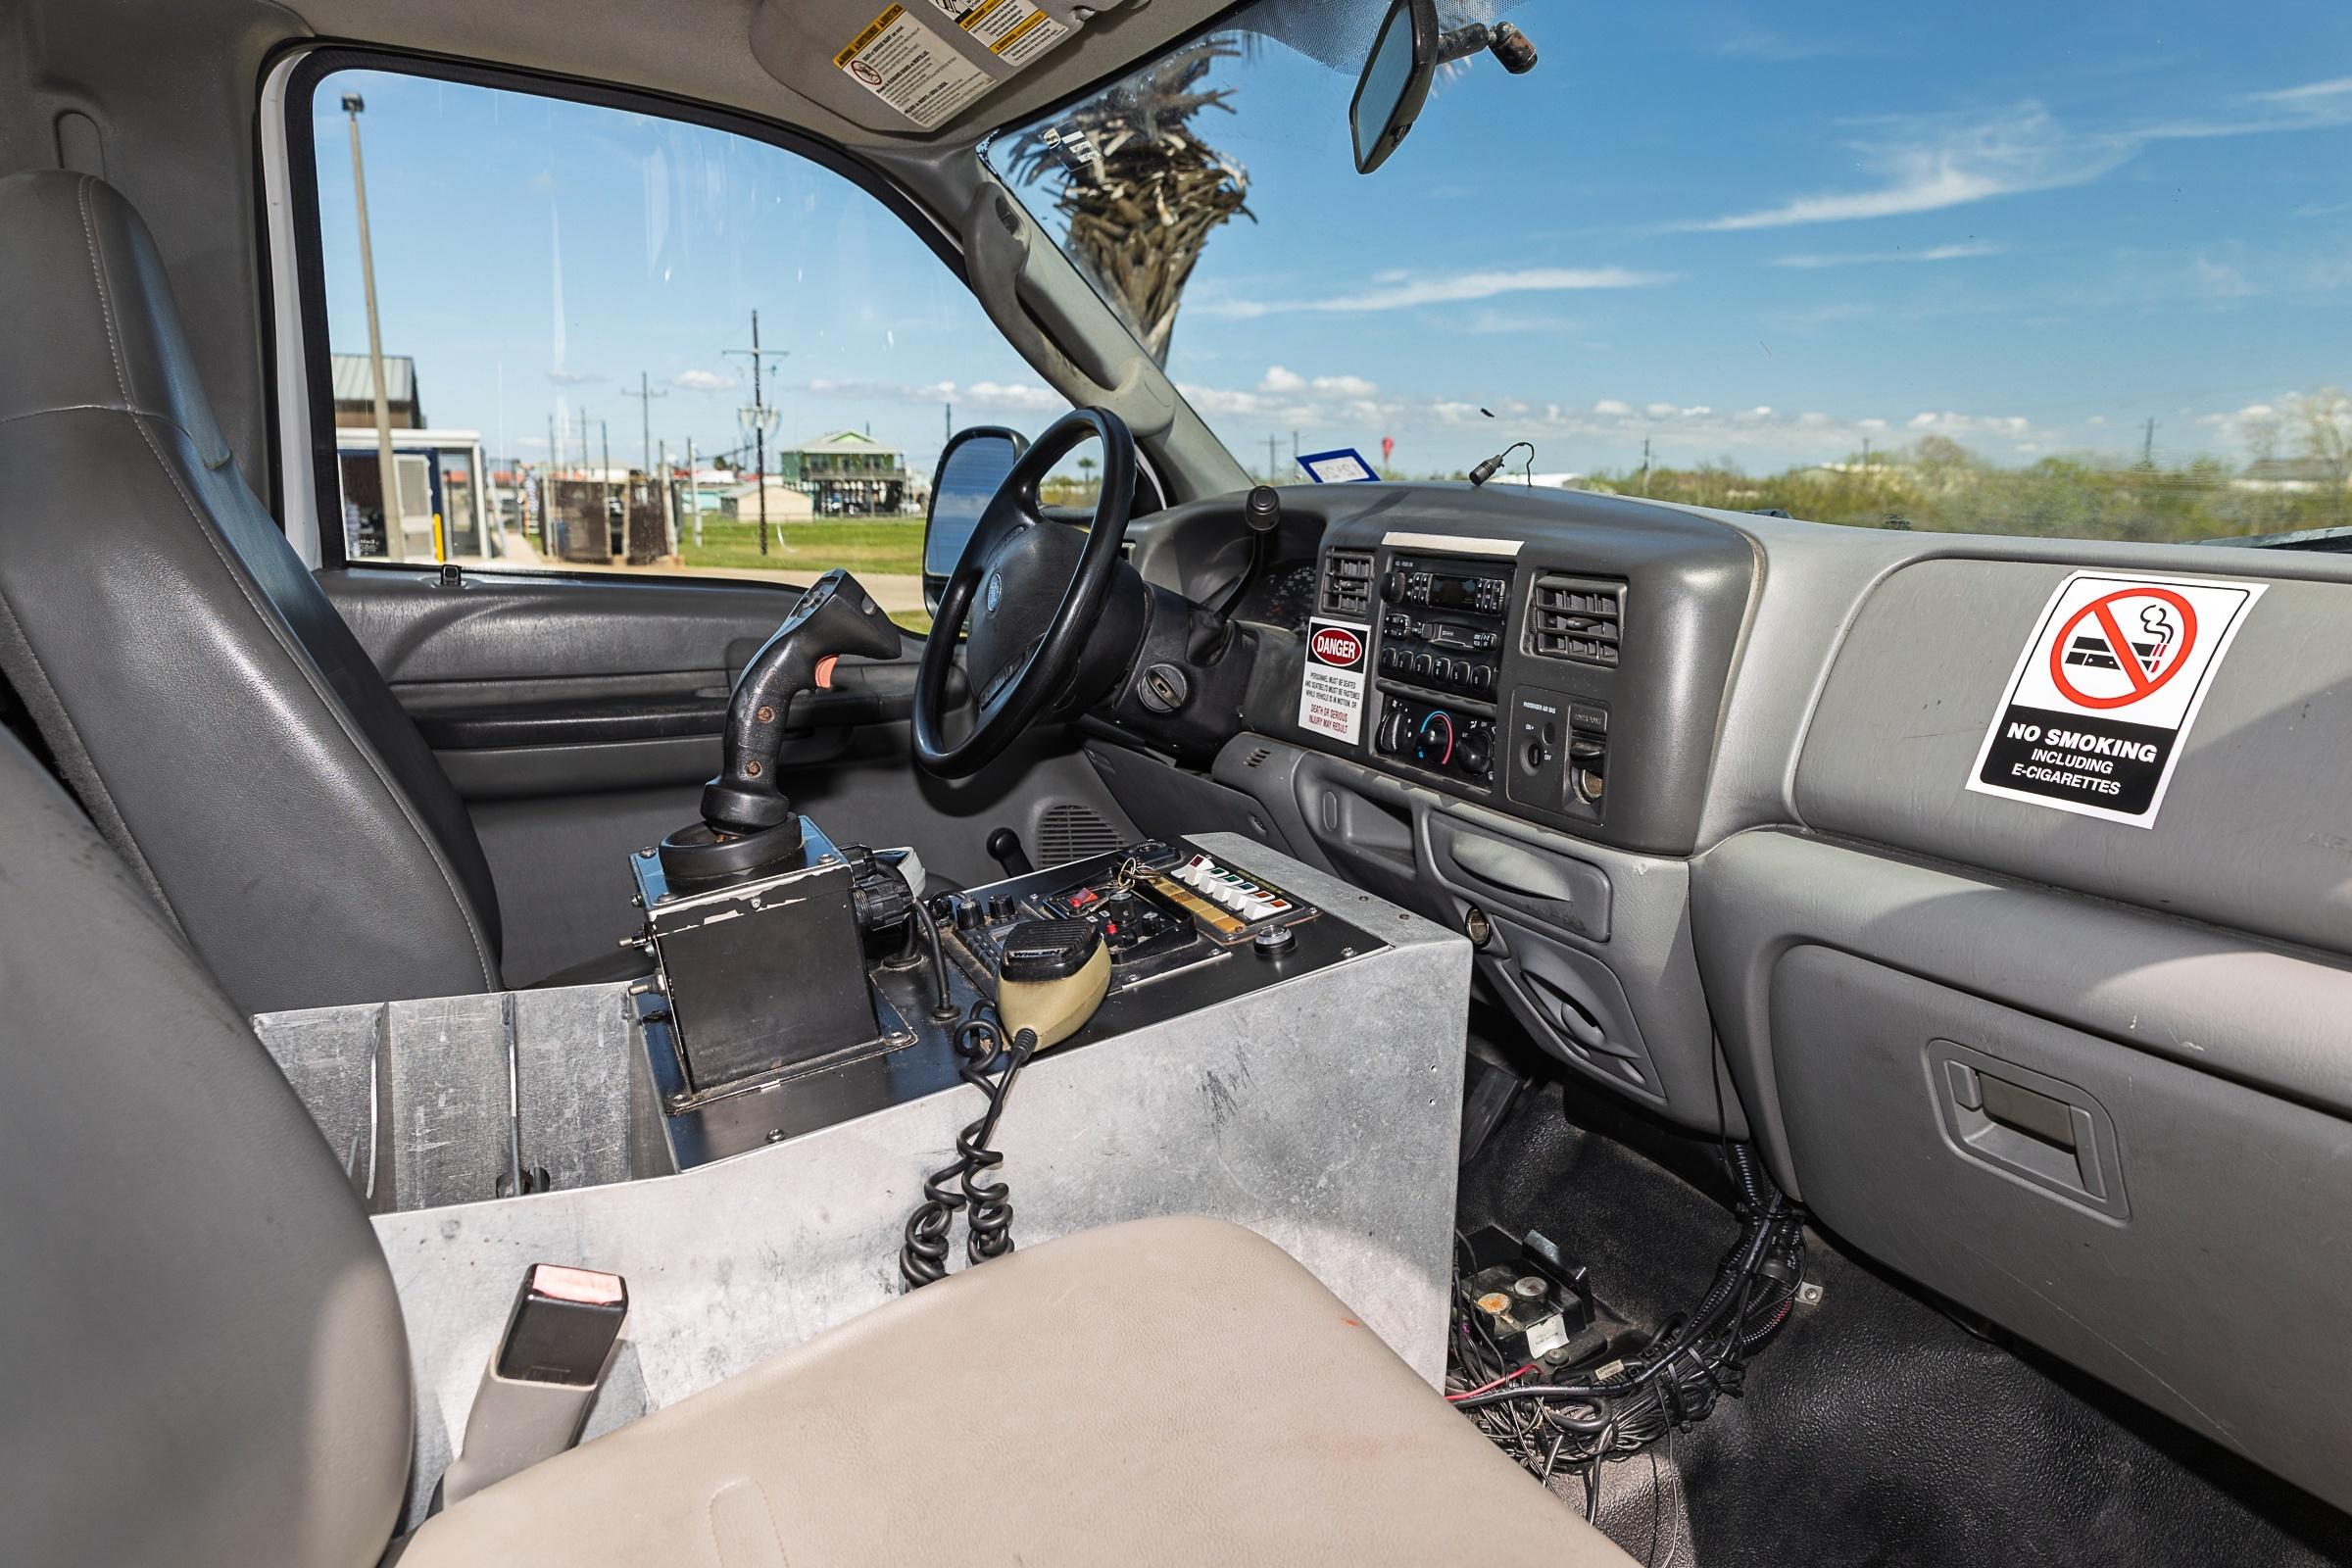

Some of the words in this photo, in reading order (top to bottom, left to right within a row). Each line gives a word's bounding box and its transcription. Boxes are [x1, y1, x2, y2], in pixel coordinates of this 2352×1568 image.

[1317, 635, 1355, 660] DANGER
[1309, 714, 1322, 724] INJURY
[1323, 718, 1332, 728] MAY
[1332, 721, 1348, 733] RESULT
[1310, 704, 1323, 713] DEATH
[1324, 708, 1329, 716] OR
[1330, 709, 1348, 722] SERIOUS
[2007, 722, 2040, 743] NO
[2044, 727, 2158, 763] SMOKING
[2031, 748, 2114, 774] INCLUDING
[2011, 763, 2122, 795] E-CIGARETTES
